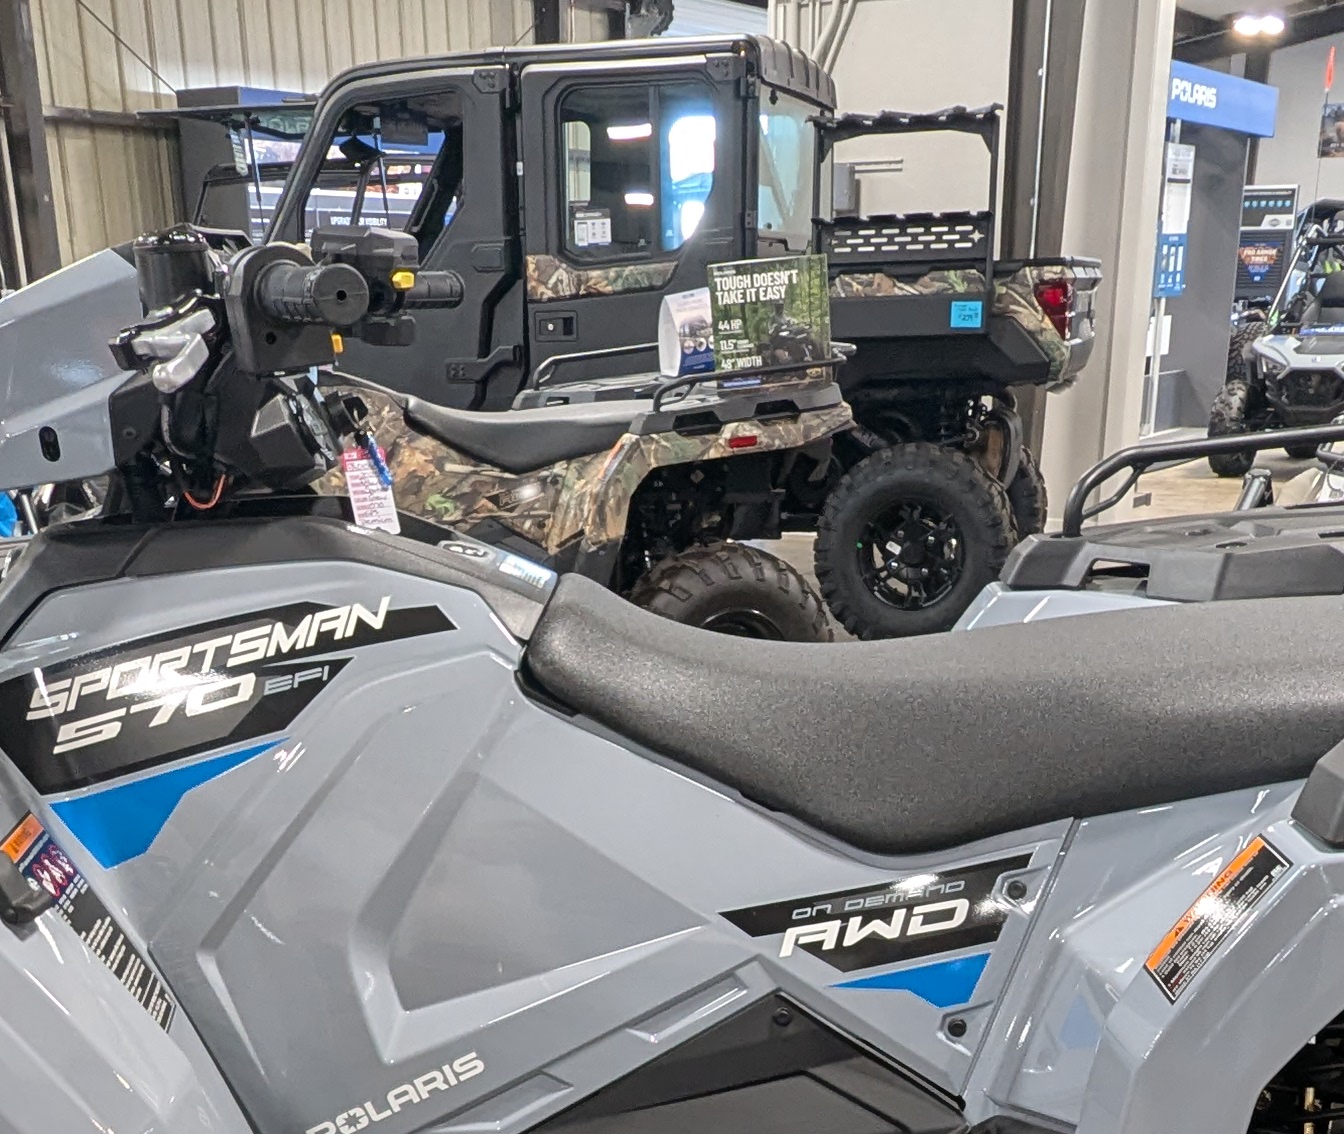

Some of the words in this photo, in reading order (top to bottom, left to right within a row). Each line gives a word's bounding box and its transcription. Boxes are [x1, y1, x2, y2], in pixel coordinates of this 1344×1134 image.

[1171, 78, 1217, 108] POLARIS
[714, 275, 752, 292] TOUGH
[754, 269, 799, 287] DOESN'T
[716, 290, 746, 305] TAKE
[746, 288, 757, 302] IT
[759, 285, 788, 300] EASY
[718, 320, 731, 331] 44
[730, 319, 743, 330] HP
[736, 355, 763, 369] WIDTH
[26, 597, 391, 720] SPORTSMAN
[53, 673, 257, 754] 570
[263, 665, 330, 696] EFI
[791, 904, 832, 920] ON
[844, 880, 966, 911] DEMAND
[778, 898, 970, 958] AWD
